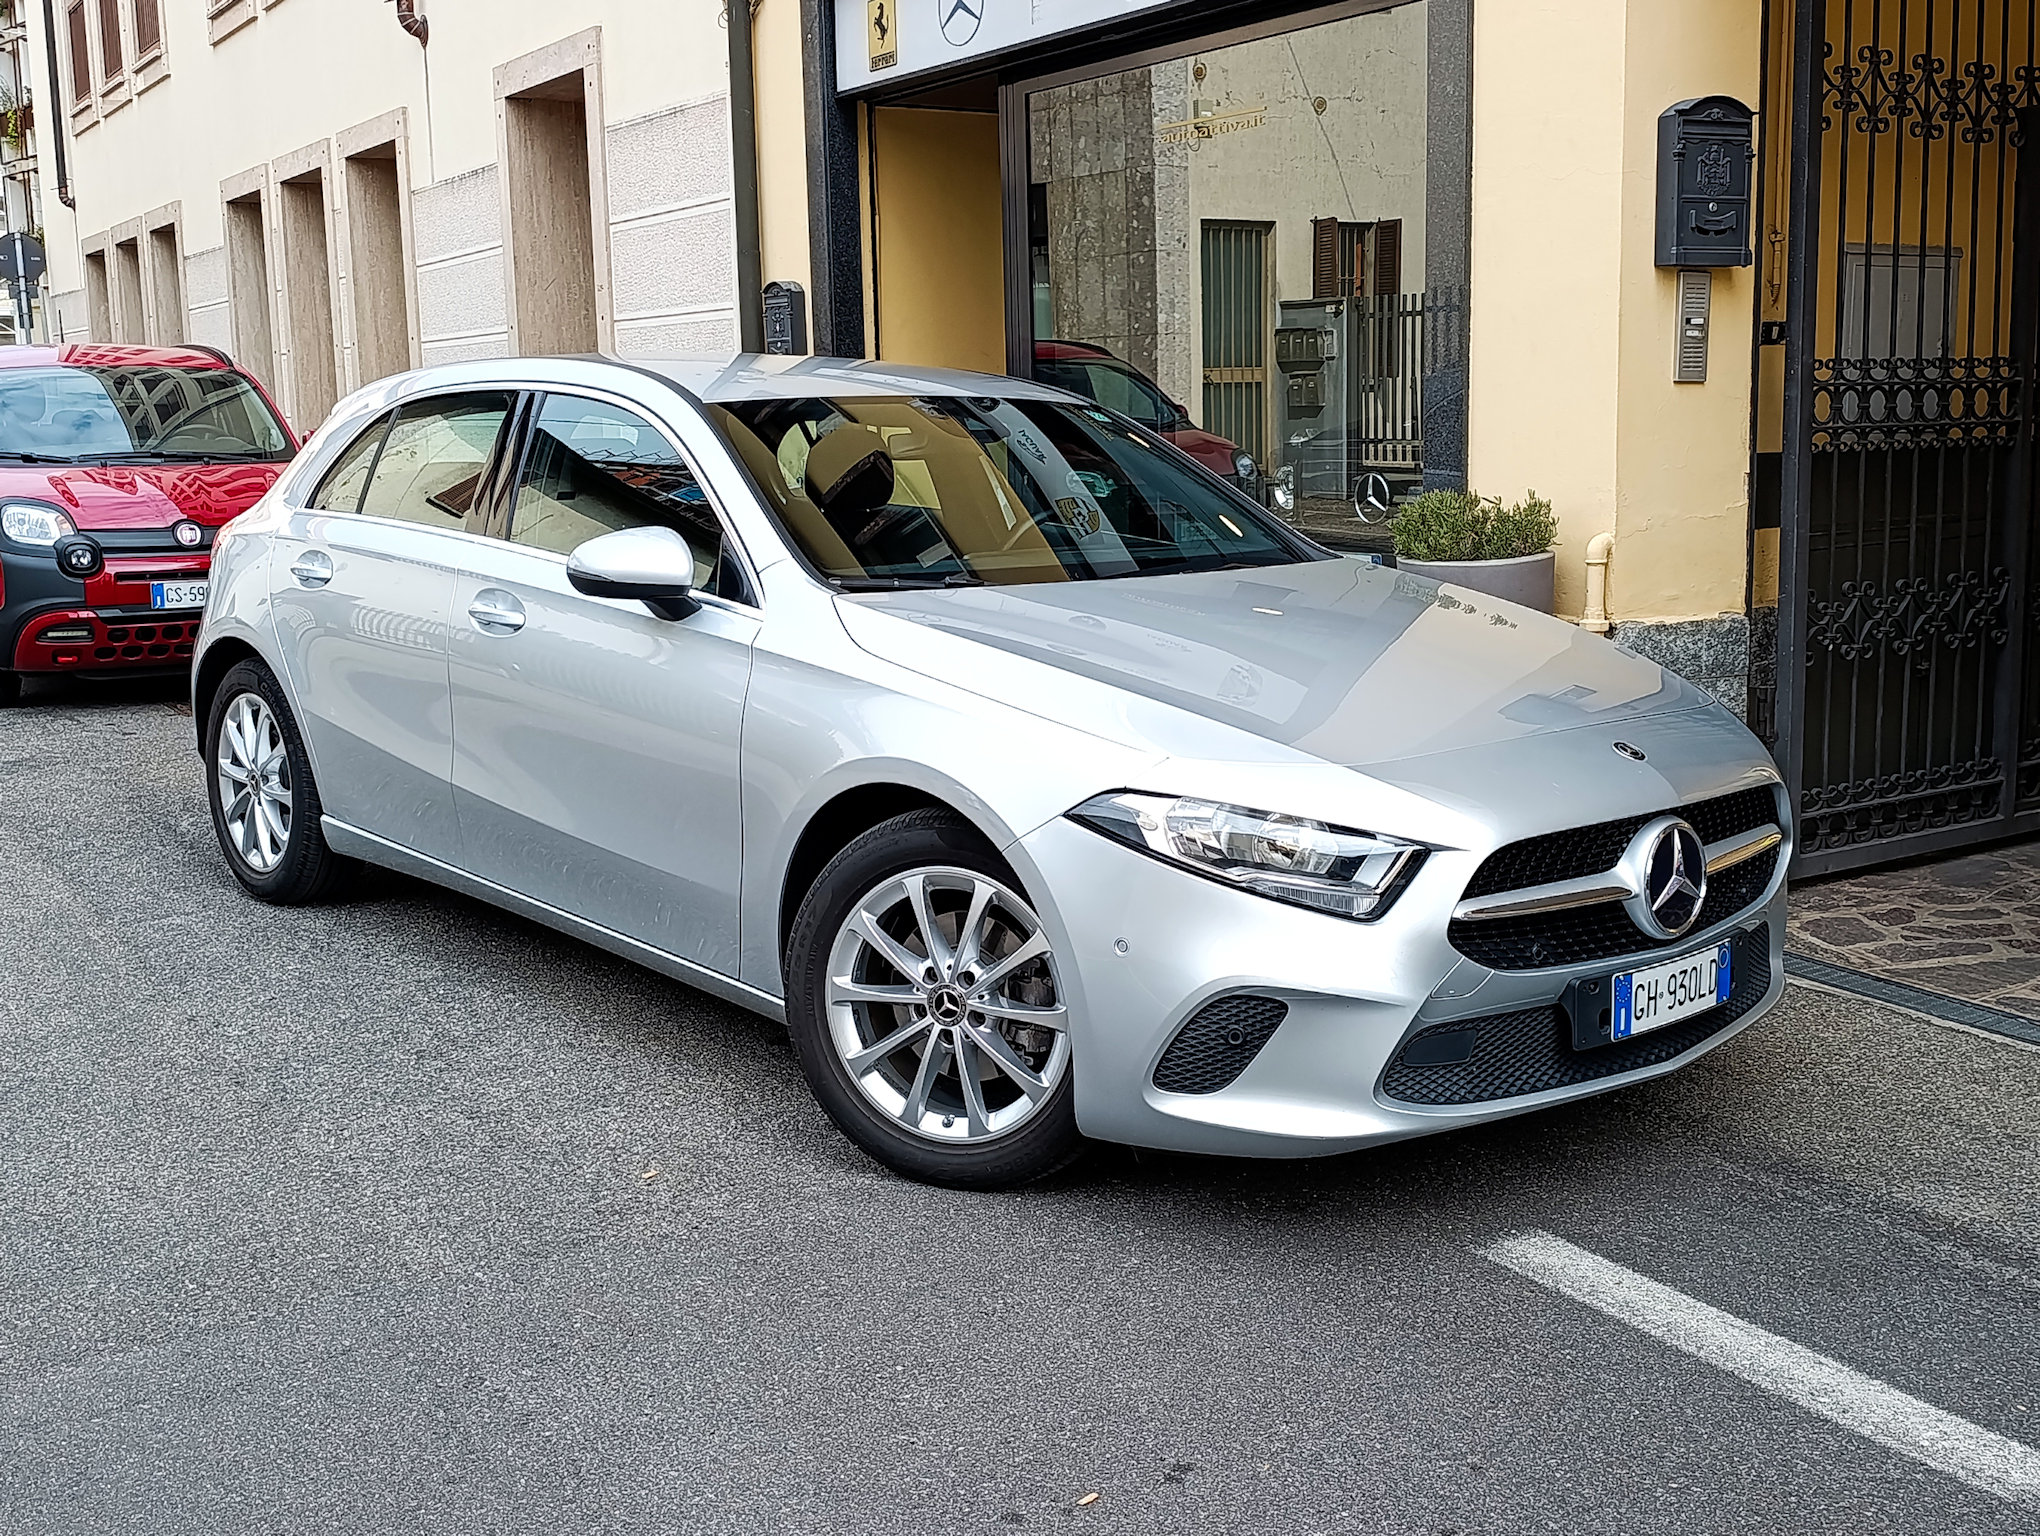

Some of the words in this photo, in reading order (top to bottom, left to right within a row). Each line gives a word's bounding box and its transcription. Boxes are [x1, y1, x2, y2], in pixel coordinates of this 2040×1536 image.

[870, 51, 895, 69] Ferrari
[1160, 115, 1266, 142] autoattiva.it
[1634, 978, 1659, 1021] GH
[1667, 958, 1718, 1011] 930LD
